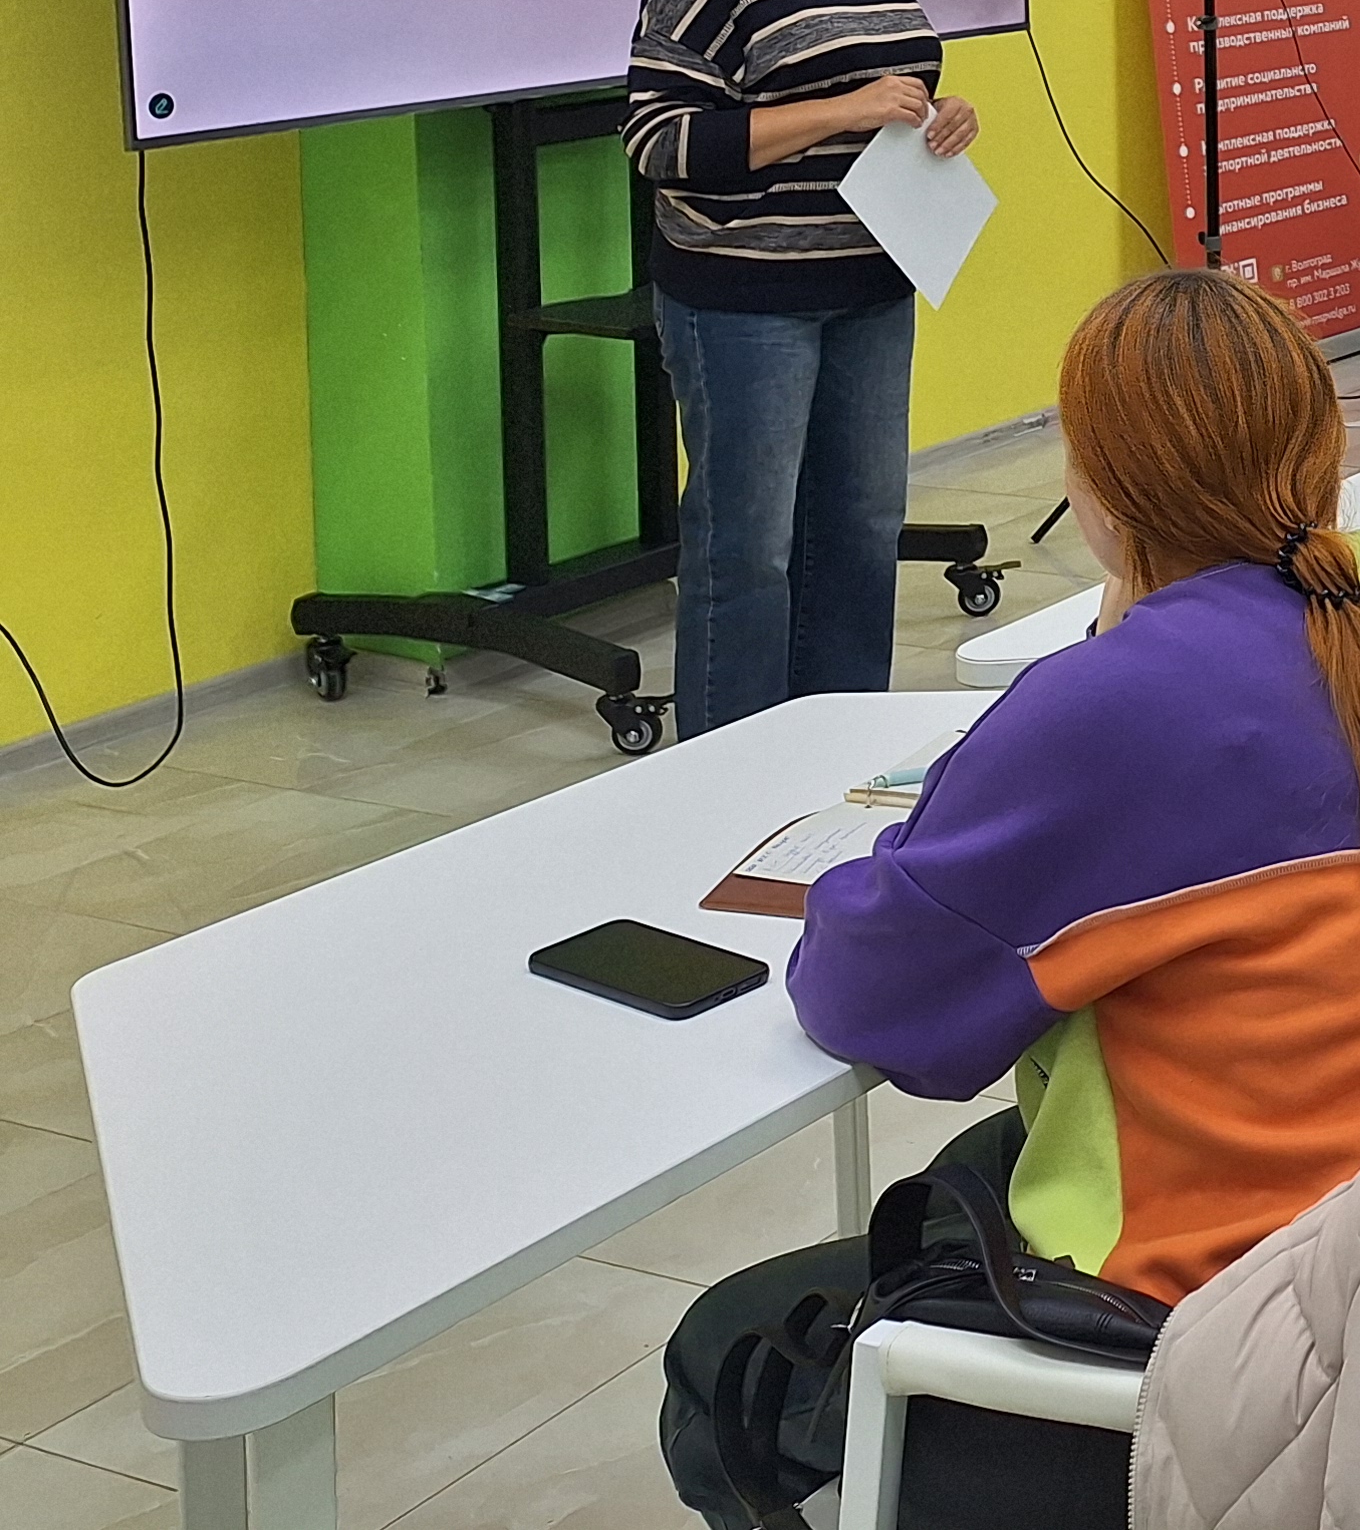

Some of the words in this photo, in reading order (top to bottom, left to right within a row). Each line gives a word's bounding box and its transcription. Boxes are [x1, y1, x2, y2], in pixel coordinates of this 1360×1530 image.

[1298, 16, 1349, 37] компаний
[1263, 181, 1324, 206] программы
[1304, 194, 1348, 214] бизнеса
[1291, 254, 1333, 272] Волгоград
[1296, 294, 1312, 308] 800
[1313, 289, 1328, 303] 302
[1335, 283, 1351, 297] 203
